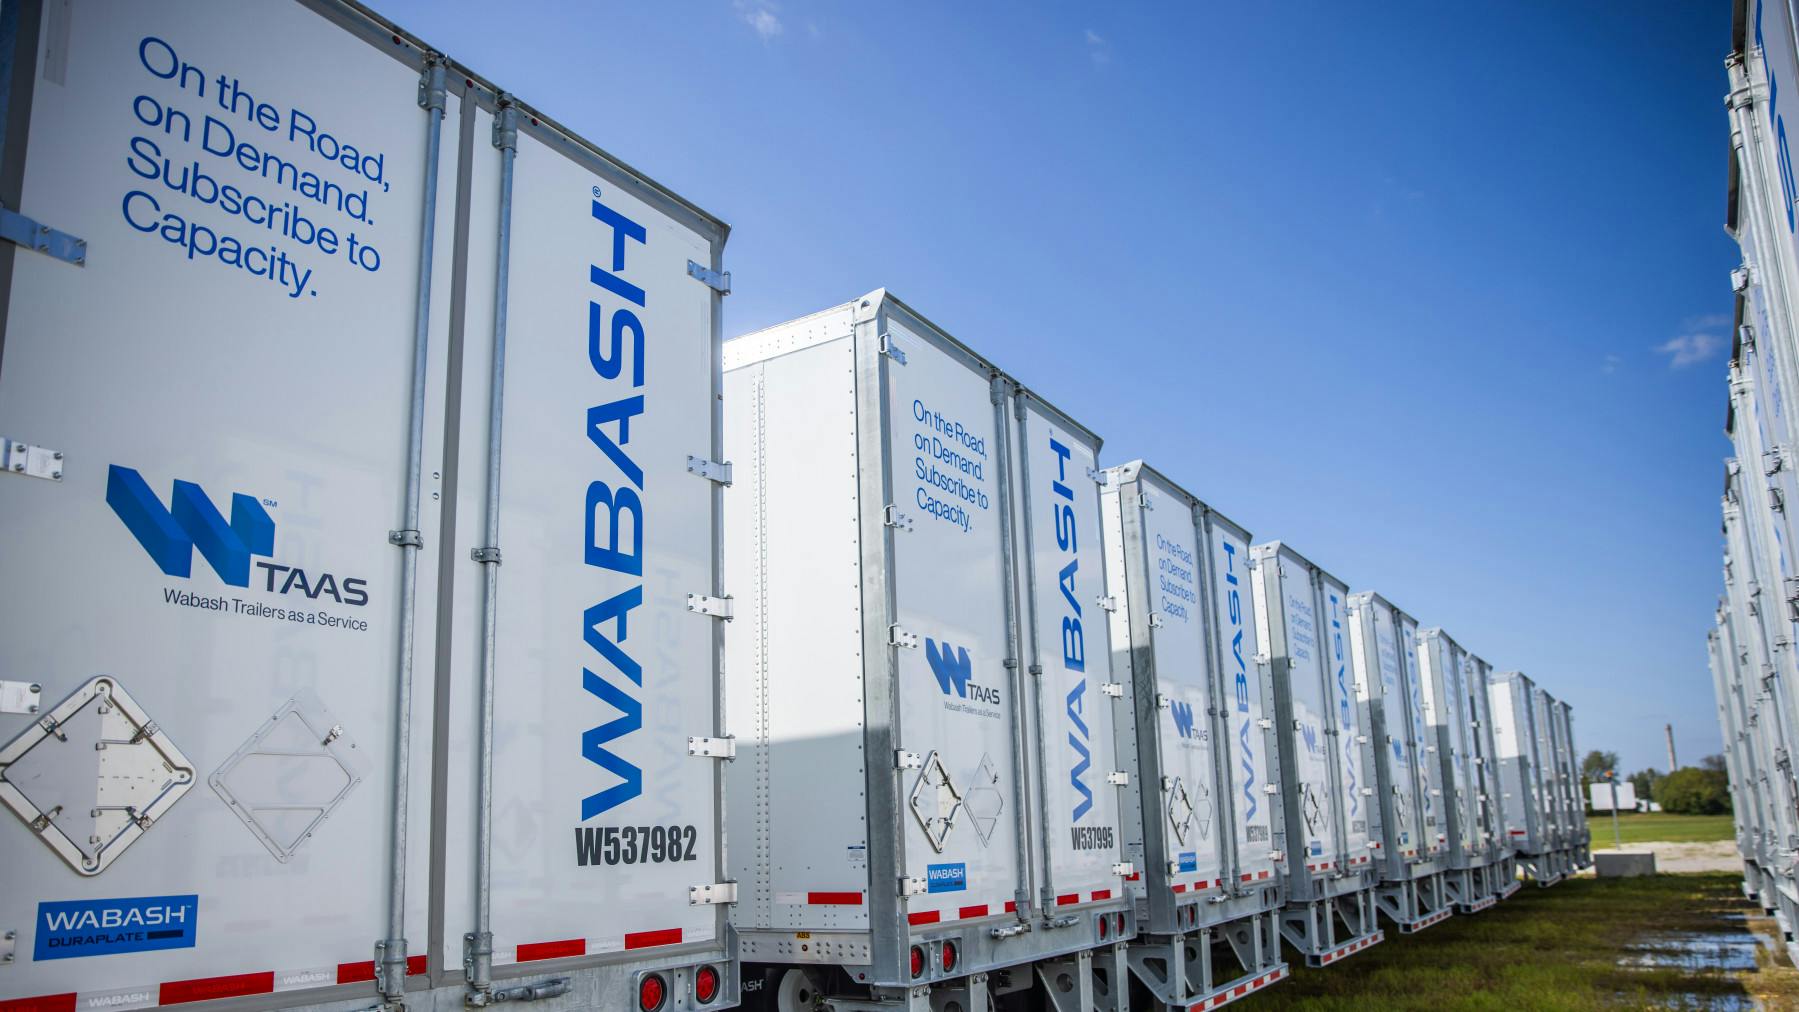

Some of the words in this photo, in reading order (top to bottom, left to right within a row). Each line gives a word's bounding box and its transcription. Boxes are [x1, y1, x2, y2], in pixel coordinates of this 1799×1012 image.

[139, 37, 205, 97] On
[215, 75, 280, 132] the
[289, 108, 390, 193] Road,
[133, 95, 191, 142] on
[202, 116, 374, 226] Demand.
[127, 136, 339, 255] Subscribe
[346, 233, 381, 272] to
[122, 190, 318, 298] Capacity.
[914, 400, 932, 428] On
[934, 412, 953, 438] the
[956, 422, 987, 461] Road,
[915, 433, 930, 455] on
[933, 437, 984, 482] Demand.
[916, 457, 975, 504] Subscribe
[977, 489, 989, 510] to
[917, 488, 972, 532] Capacity.
[256, 561, 369, 607] TAAS
[164, 587, 229, 612] Wabash
[232, 598, 286, 621] Trailers
[288, 609, 305, 624] as
[306, 612, 316, 625] a
[317, 611, 368, 632] Service
[1050, 438, 1093, 823] WABASH
[967, 683, 1001, 705] TAAS
[1223, 541, 1257, 823] WABASH
[575, 825, 697, 867] W537982
[1071, 827, 1114, 850] W537995
[929, 868, 963, 880] WABASH
[45, 905, 187, 931] WABASH
[48, 931, 144, 948] DURAPLATE
[89, 992, 149, 1007] WABASH
[284, 972, 330, 985] WABASH
